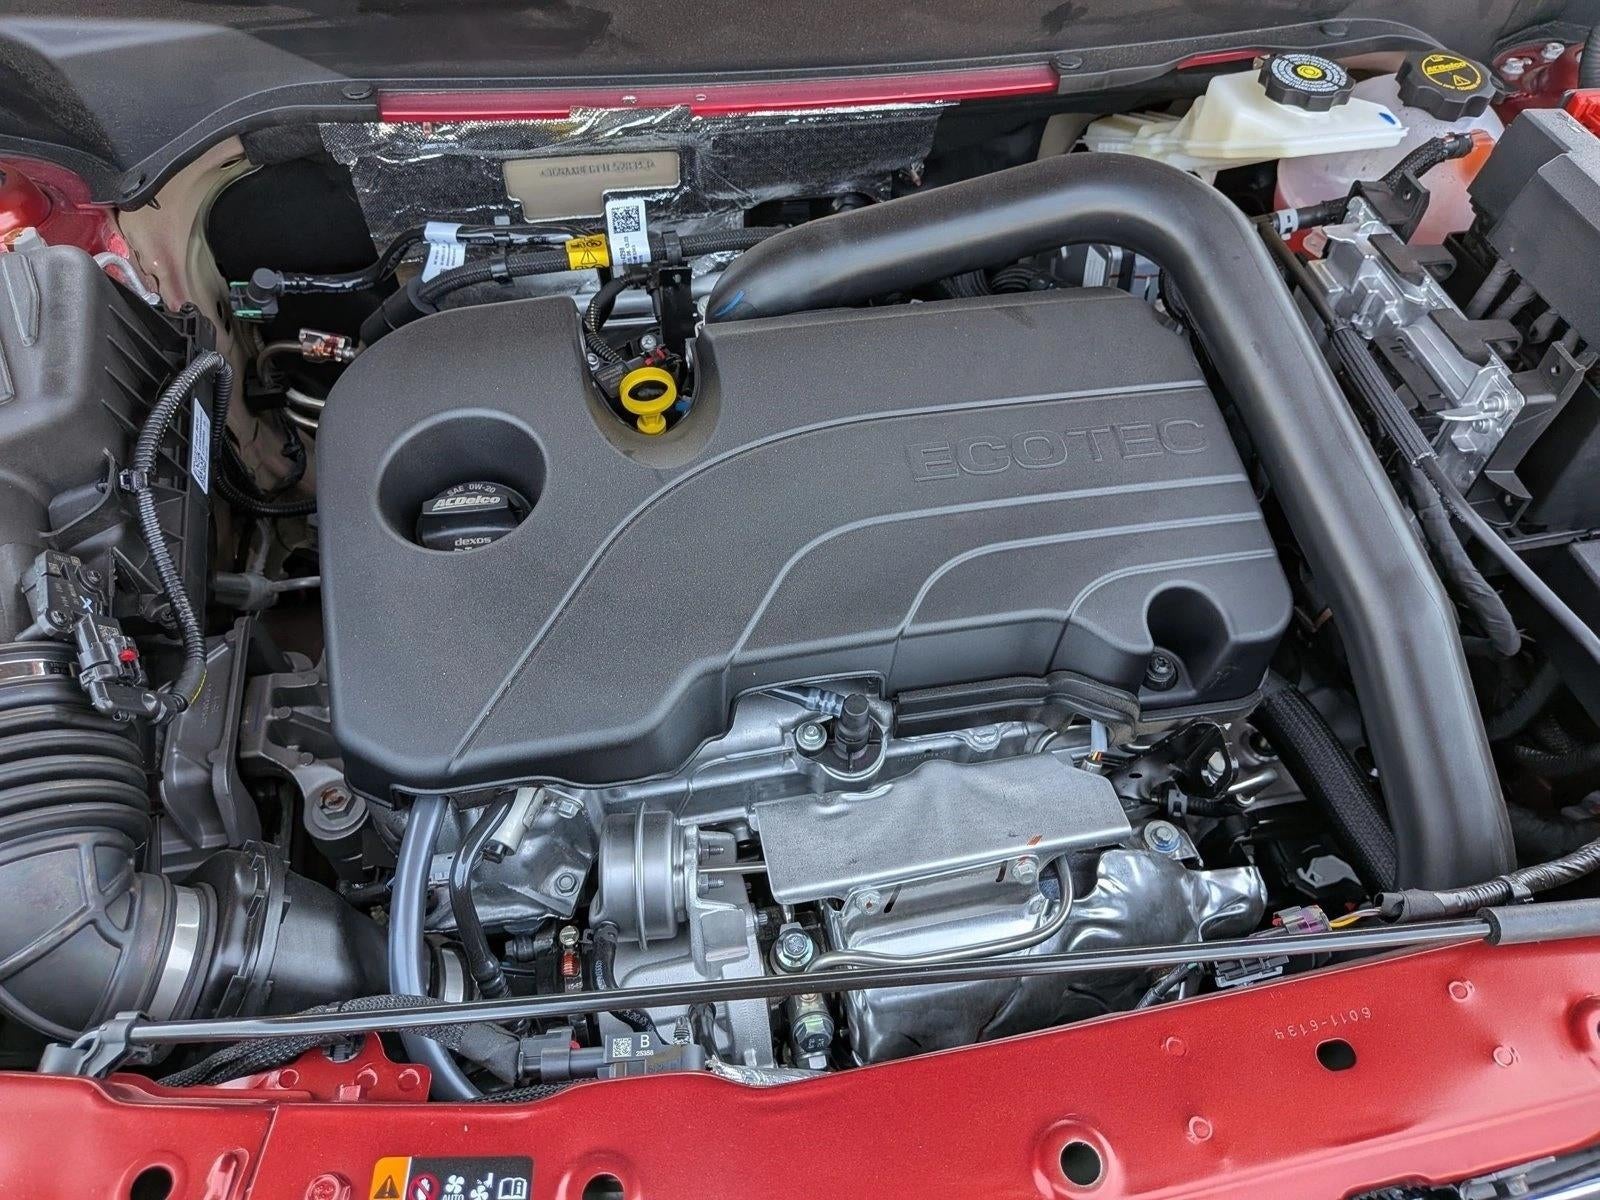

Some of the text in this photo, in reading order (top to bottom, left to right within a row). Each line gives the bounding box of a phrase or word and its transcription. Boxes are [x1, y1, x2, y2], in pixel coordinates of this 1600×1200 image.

[905, 416, 1210, 482] ECOTEC
[447, 484, 496, 496] SAE 0W-20
[432, 495, 501, 511] ACDelco
[454, 537, 492, 547] dexos
[1273, 1006, 1373, 1040] 6011-6134
[640, 1034, 650, 1048] B
